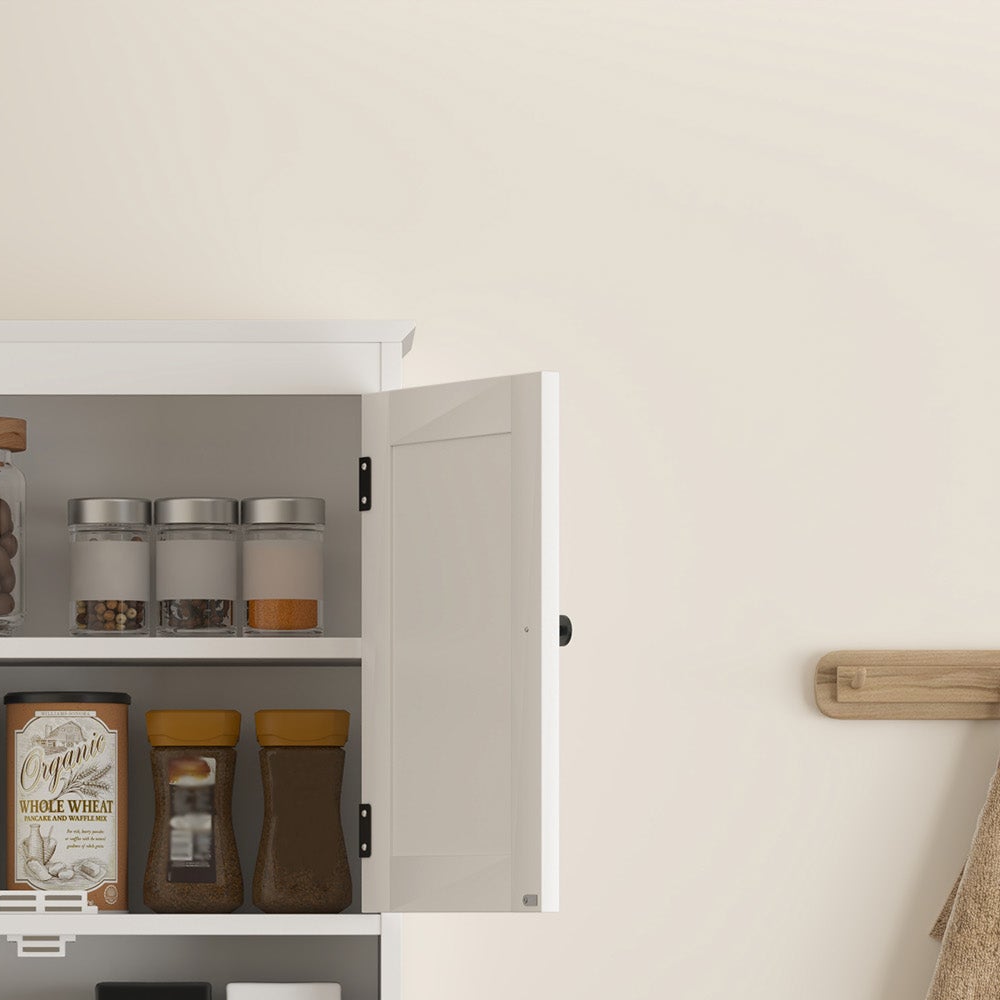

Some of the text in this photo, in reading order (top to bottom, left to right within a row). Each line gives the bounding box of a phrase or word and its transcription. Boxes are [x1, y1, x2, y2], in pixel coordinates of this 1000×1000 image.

[20, 732, 106, 794] Organic
[19, 800, 114, 813] WHOLE WHEAT
